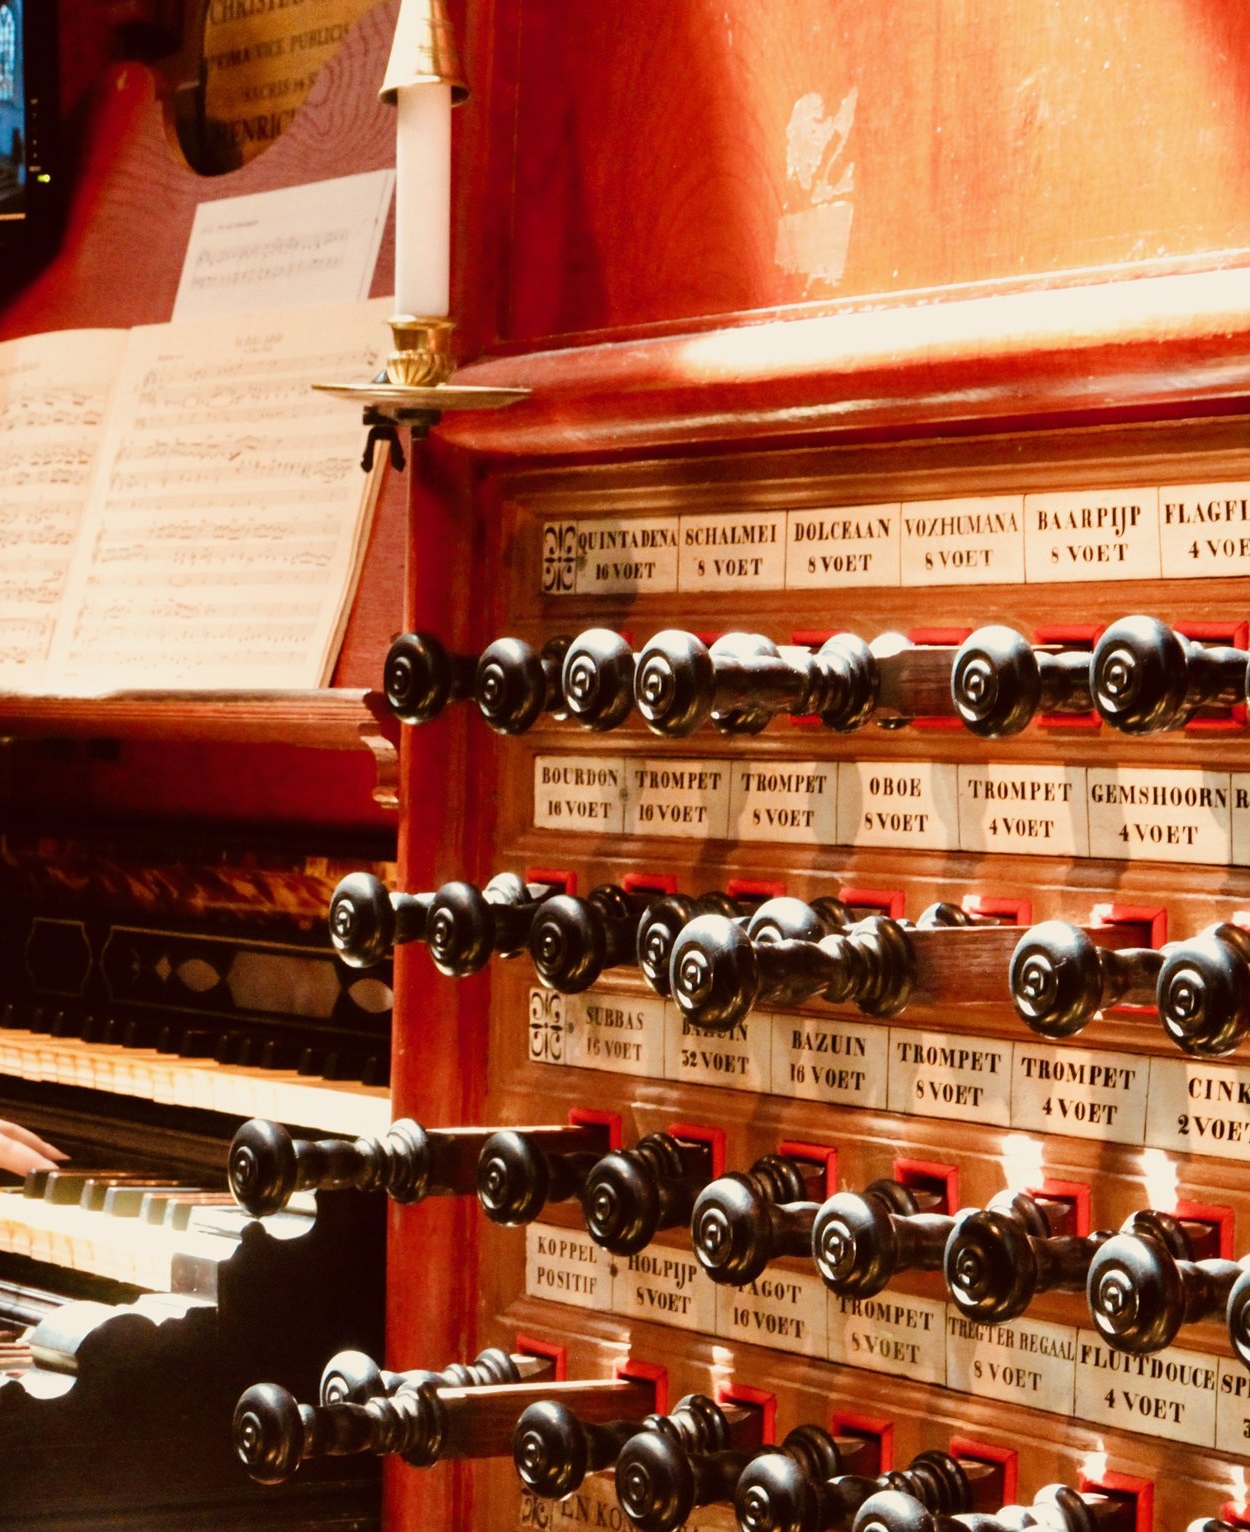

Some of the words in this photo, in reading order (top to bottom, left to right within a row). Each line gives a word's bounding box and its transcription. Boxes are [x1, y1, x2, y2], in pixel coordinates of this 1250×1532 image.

[794, 518, 891, 542] DOLCEAAN
[904, 512, 1018, 537] VOXHUMANA
[1037, 505, 1141, 537] BAARPIJP
[578, 529, 678, 552] QUINTADENA
[685, 524, 777, 546] SCHALMEI
[924, 552, 933, 570] 8
[940, 549, 994, 568] VOET
[1067, 543, 1129, 563] VOET
[1188, 541, 1199, 559] 4
[595, 563, 609, 580] 16
[613, 562, 656, 580] VOET
[713, 558, 763, 577] VOET
[808, 555, 816, 574] 8
[820, 554, 873, 573] VOET
[541, 767, 619, 787] BOURDON
[634, 770, 722, 791] TROMPET
[741, 773, 828, 794] TROMPET
[869, 777, 922, 798] OBOE
[968, 779, 1073, 803] TROMPET
[1091, 783, 1228, 809] GEMSHOORN
[548, 800, 561, 817] 16
[566, 801, 612, 819] VOET
[638, 804, 653, 821] 16
[657, 804, 707, 823] VOET
[753, 810, 761, 827] 8
[765, 810, 815, 828] VOET
[864, 812, 873, 830] 8
[876, 813, 928, 833] VOET
[988, 819, 998, 836] 4
[1002, 818, 1054, 839] VOET
[1118, 824, 1129, 843] 4
[1133, 825, 1198, 846] VOET
[586, 1006, 645, 1031] SUBBAS
[605, 1040, 642, 1062] VOET
[791, 1029, 867, 1057] BAZUIN
[681, 1049, 698, 1069] 32
[700, 1051, 750, 1075] VOET
[897, 1042, 1002, 1075] TROMPET
[789, 1063, 805, 1084] 16
[811, 1066, 866, 1091] VOET
[1021, 1056, 1136, 1091] TROMPET
[916, 1080, 925, 1099] 8
[929, 1081, 984, 1107] VOET
[1042, 1098, 1053, 1116] 4
[1058, 1098, 1118, 1126] VOET
[1177, 1114, 1190, 1135] 2
[537, 1236, 598, 1265] KOPPEL
[537, 1266, 598, 1295] POSITIF
[628, 1254, 697, 1290] HOLPIJP
[645, 1287, 692, 1315] VOET
[733, 1306, 750, 1328] 16
[752, 1310, 805, 1339] VOET
[863, 1334, 921, 1364] VOET
[1019, 1331, 1075, 1361] REGAAL
[973, 1360, 983, 1379] 8
[988, 1362, 1042, 1391] VOET
[1080, 1343, 1216, 1391] FLUITDOUCE
[1221, 1374, 1250, 1398] SP
[1104, 1388, 1116, 1409] 4
[1121, 1390, 1185, 1424] VOET
